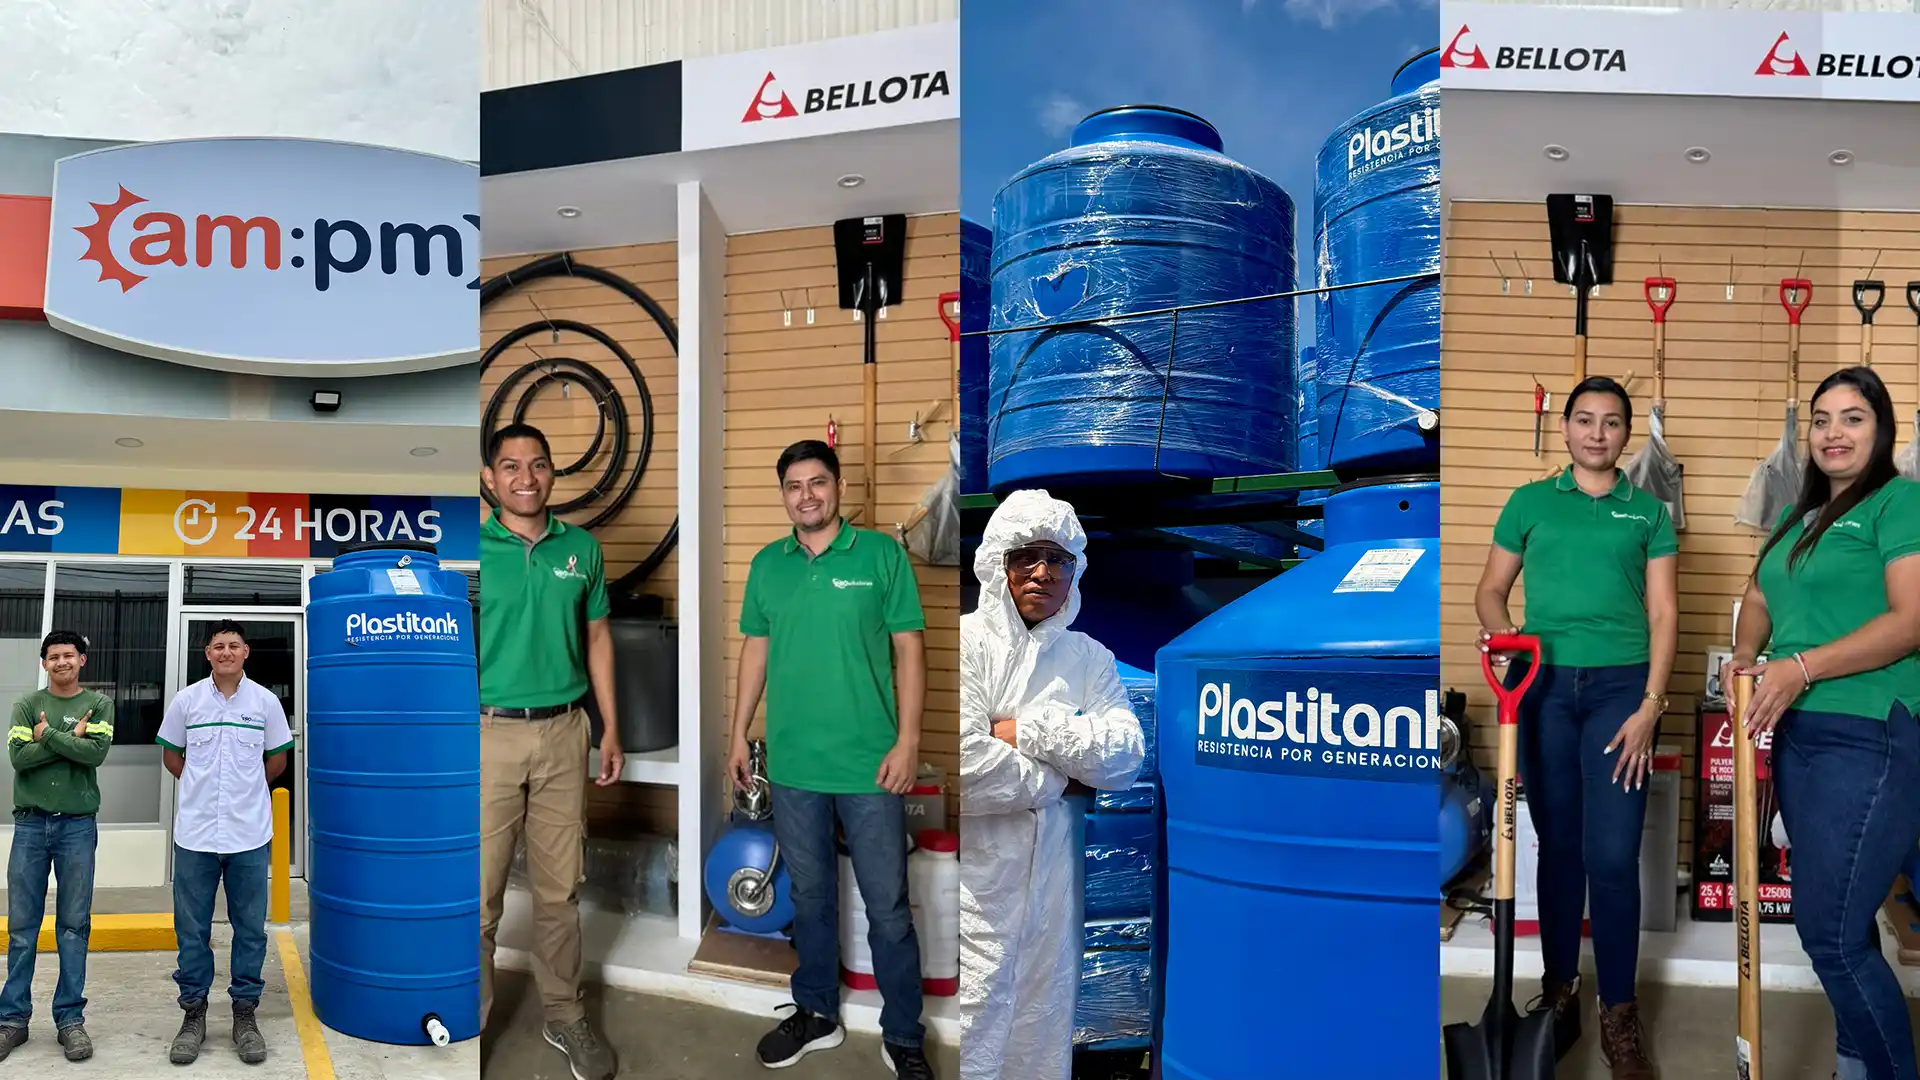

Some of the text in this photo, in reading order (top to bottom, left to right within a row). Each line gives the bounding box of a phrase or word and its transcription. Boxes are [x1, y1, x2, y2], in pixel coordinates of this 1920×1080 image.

[1495, 46, 1626, 72] BELLOTA
[804, 70, 950, 114] BELLOTA
[1348, 144, 1430, 181] RESISTENCIA POR
[129, 211, 464, 292] am:pm
[233, 506, 442, 543] 24 HORAS
[346, 611, 459, 636] Plastitank
[414, 634, 459, 642] GENERACIONES
[1198, 740, 1273, 759] RESISTENCIA
[1281, 748, 1312, 762] POR
[1504, 777, 1515, 826] BELLOTA
[1701, 885, 1722, 897] 25.4
[1704, 897, 1718, 907] CC
[1776, 902, 1791, 914] kW
[1740, 899, 1750, 960] BELLOTA
